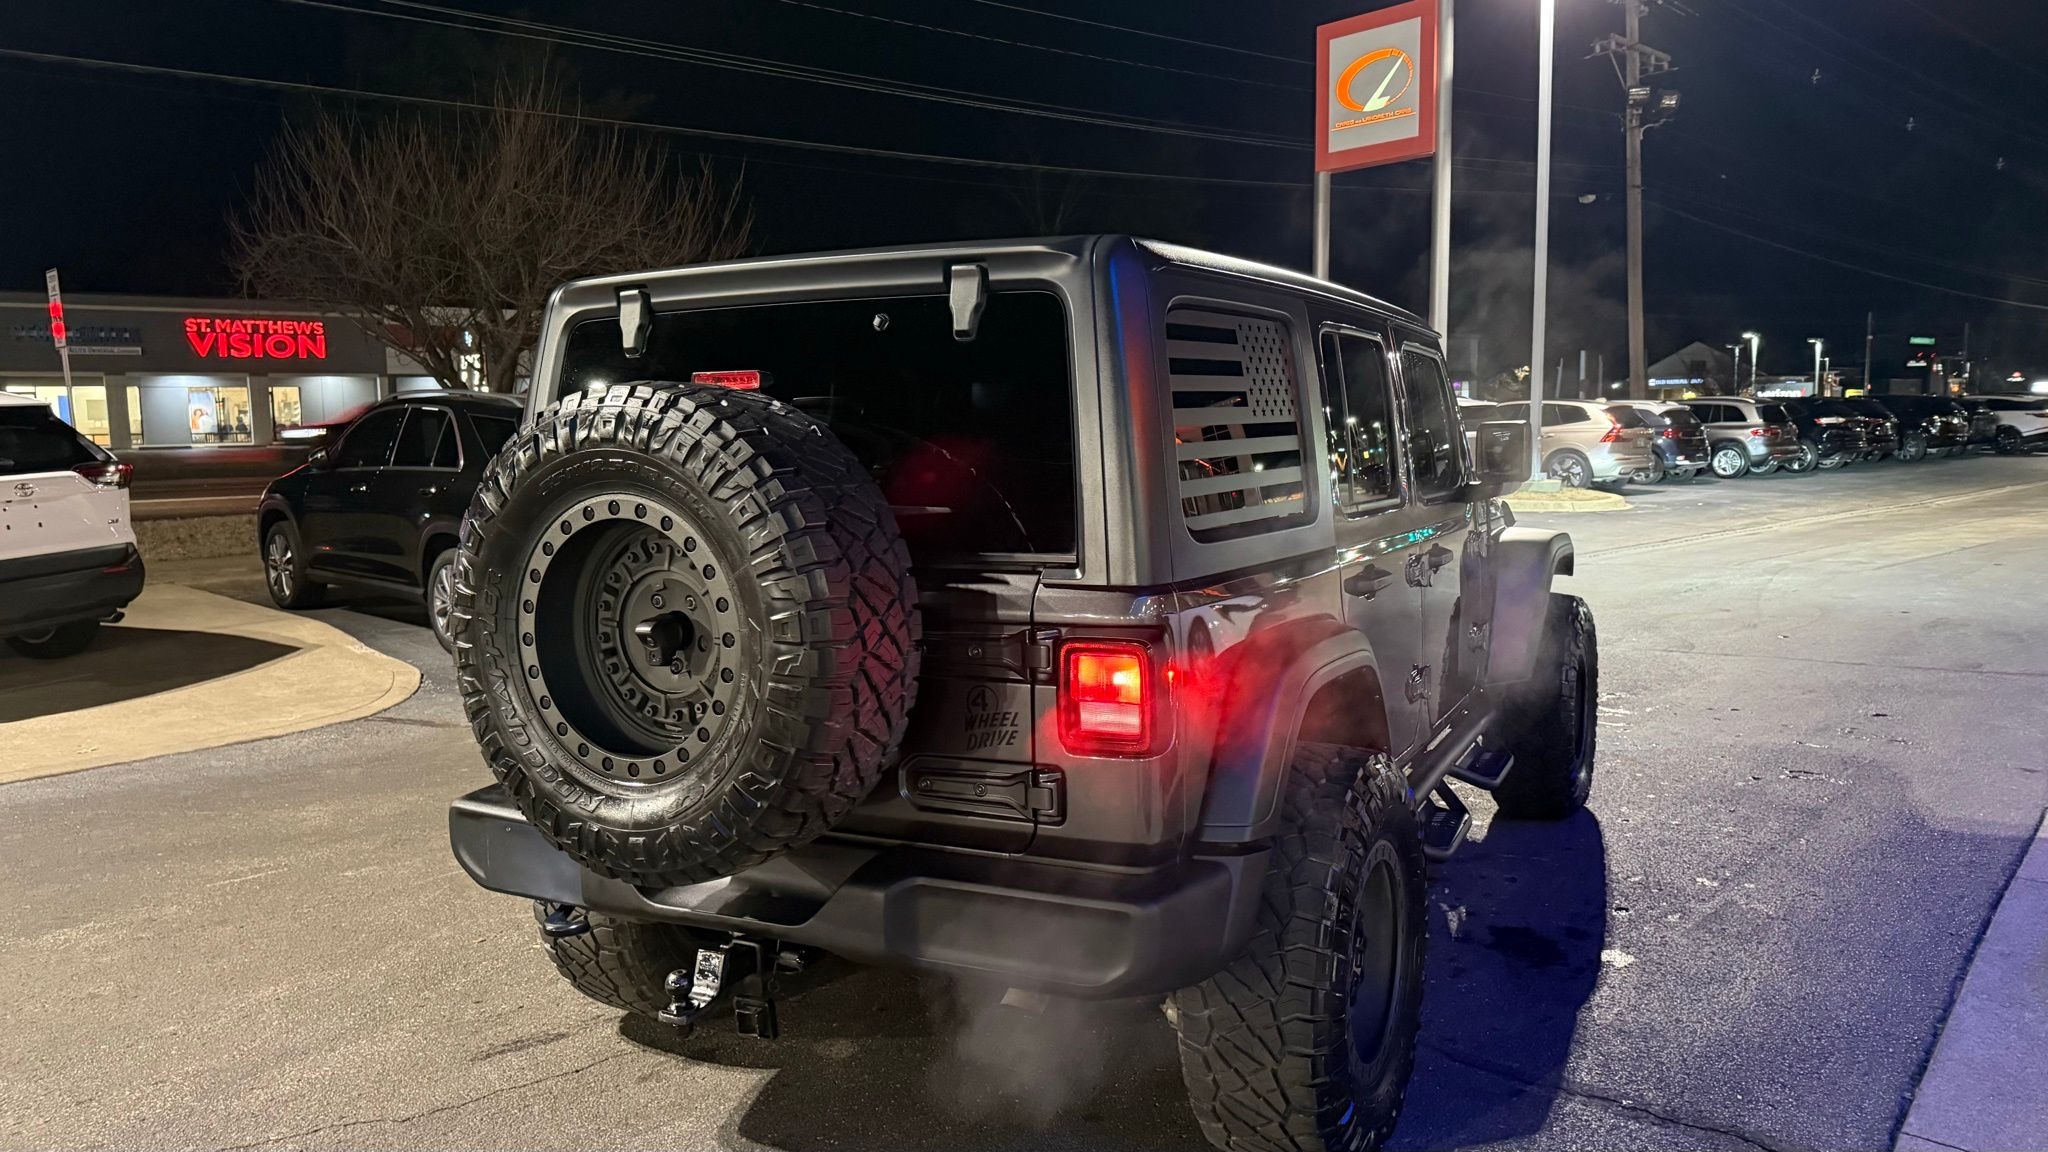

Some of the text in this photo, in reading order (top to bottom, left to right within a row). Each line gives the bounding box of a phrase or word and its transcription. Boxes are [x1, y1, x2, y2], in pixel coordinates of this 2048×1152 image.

[185, 318, 210, 332] ST.
[187, 333, 326, 359] VISION
[964, 711, 1019, 732] WHEEL
[967, 729, 1018, 751] DRIVE
[523, 748, 606, 813] RIDGE
